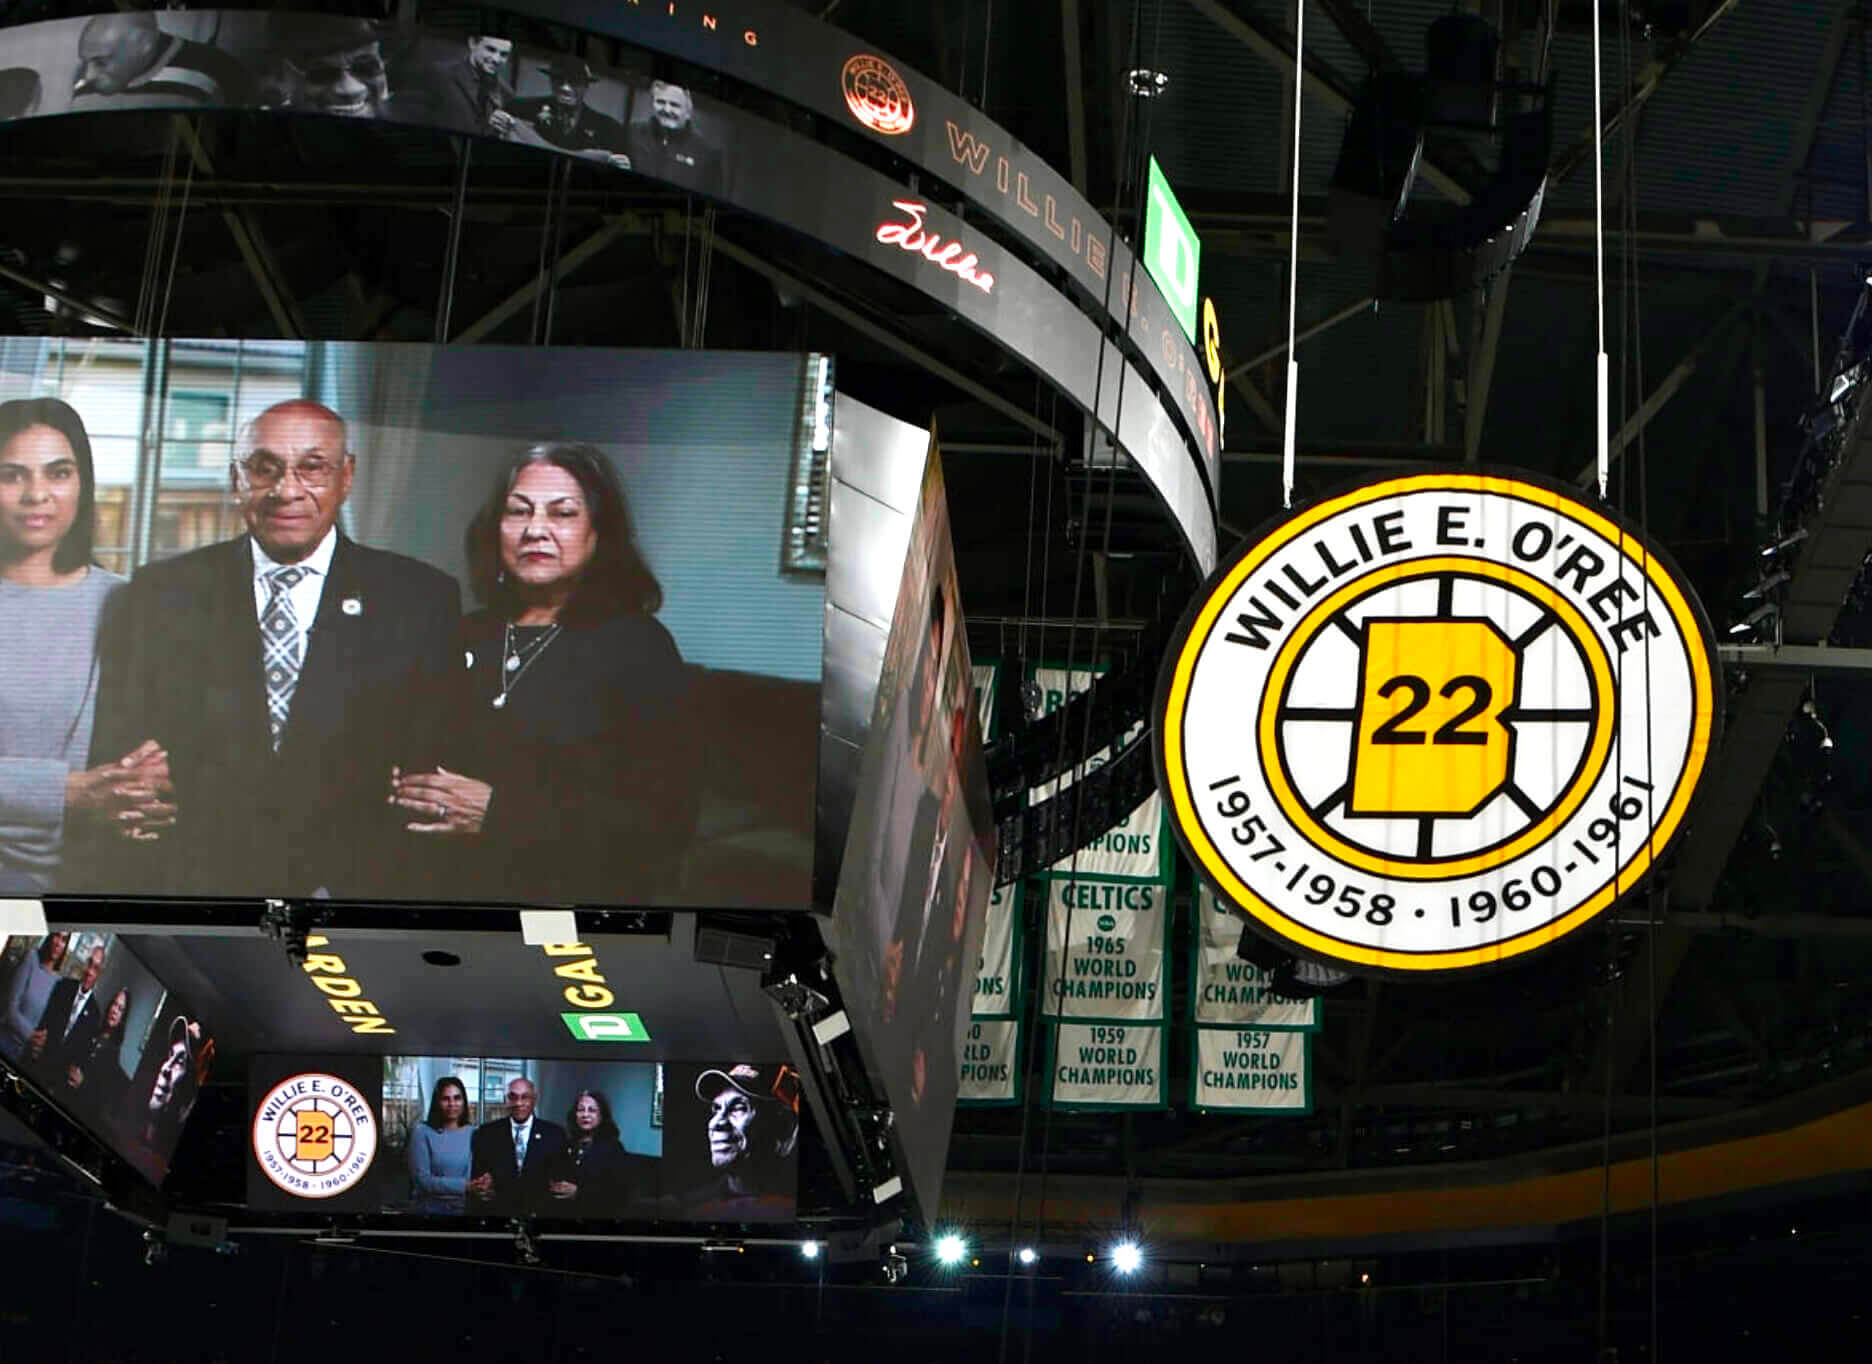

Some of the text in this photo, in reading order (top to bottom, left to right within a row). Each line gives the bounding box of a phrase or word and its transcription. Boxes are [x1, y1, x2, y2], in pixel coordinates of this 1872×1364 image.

[946, 120, 1105, 279] WILLIE
[1224, 506, 1662, 653] WILLIE E. O'REE
[1371, 675, 1493, 746] 22
[1088, 834, 1151, 854] PIONS
[1208, 775, 1655, 928] 1957-1958 1960-1961
[1062, 885, 1153, 911] CELTICS
[1087, 936, 1126, 954] 1965
[1074, 958, 1137, 977] WORLD
[1053, 978, 1157, 1000] CHAMPIONS
[1090, 1028, 1126, 1044] 1959
[1237, 1032, 1271, 1049] 1957
[1079, 1048, 1137, 1065] WORLD
[1223, 1053, 1281, 1070] WORLD
[961, 1064, 1008, 1082] PIONS
[1058, 1066, 1154, 1086] CHAMPIONS
[1203, 1071, 1298, 1089] CHAMPIONS
[262, 1081, 307, 1122] WILLIE
[331, 1085, 369, 1126] O'REE
[299, 1125, 329, 1144] 22
